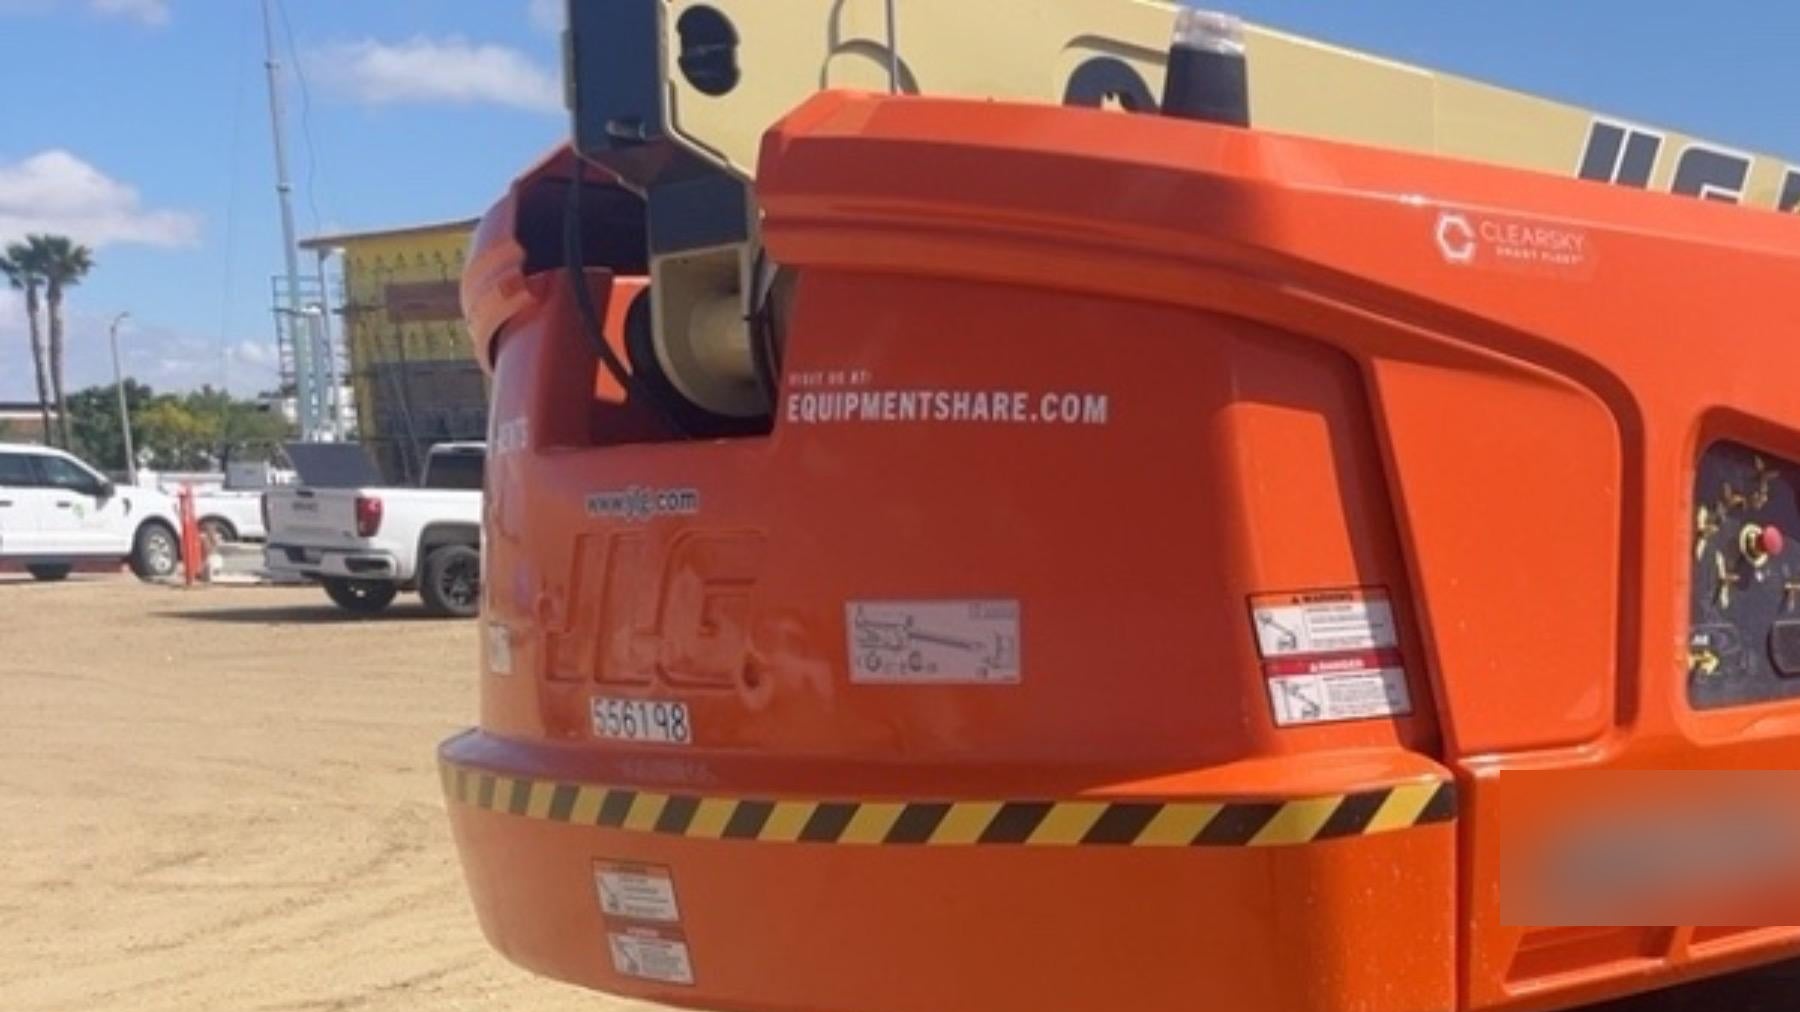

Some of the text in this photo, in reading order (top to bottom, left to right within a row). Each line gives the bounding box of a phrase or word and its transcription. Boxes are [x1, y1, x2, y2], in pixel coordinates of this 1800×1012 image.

[1479, 220, 1586, 253] CLEARSKY
[787, 391, 1108, 424] EQUIPMENTSHARE.COM
[593, 699, 688, 742] 556198
